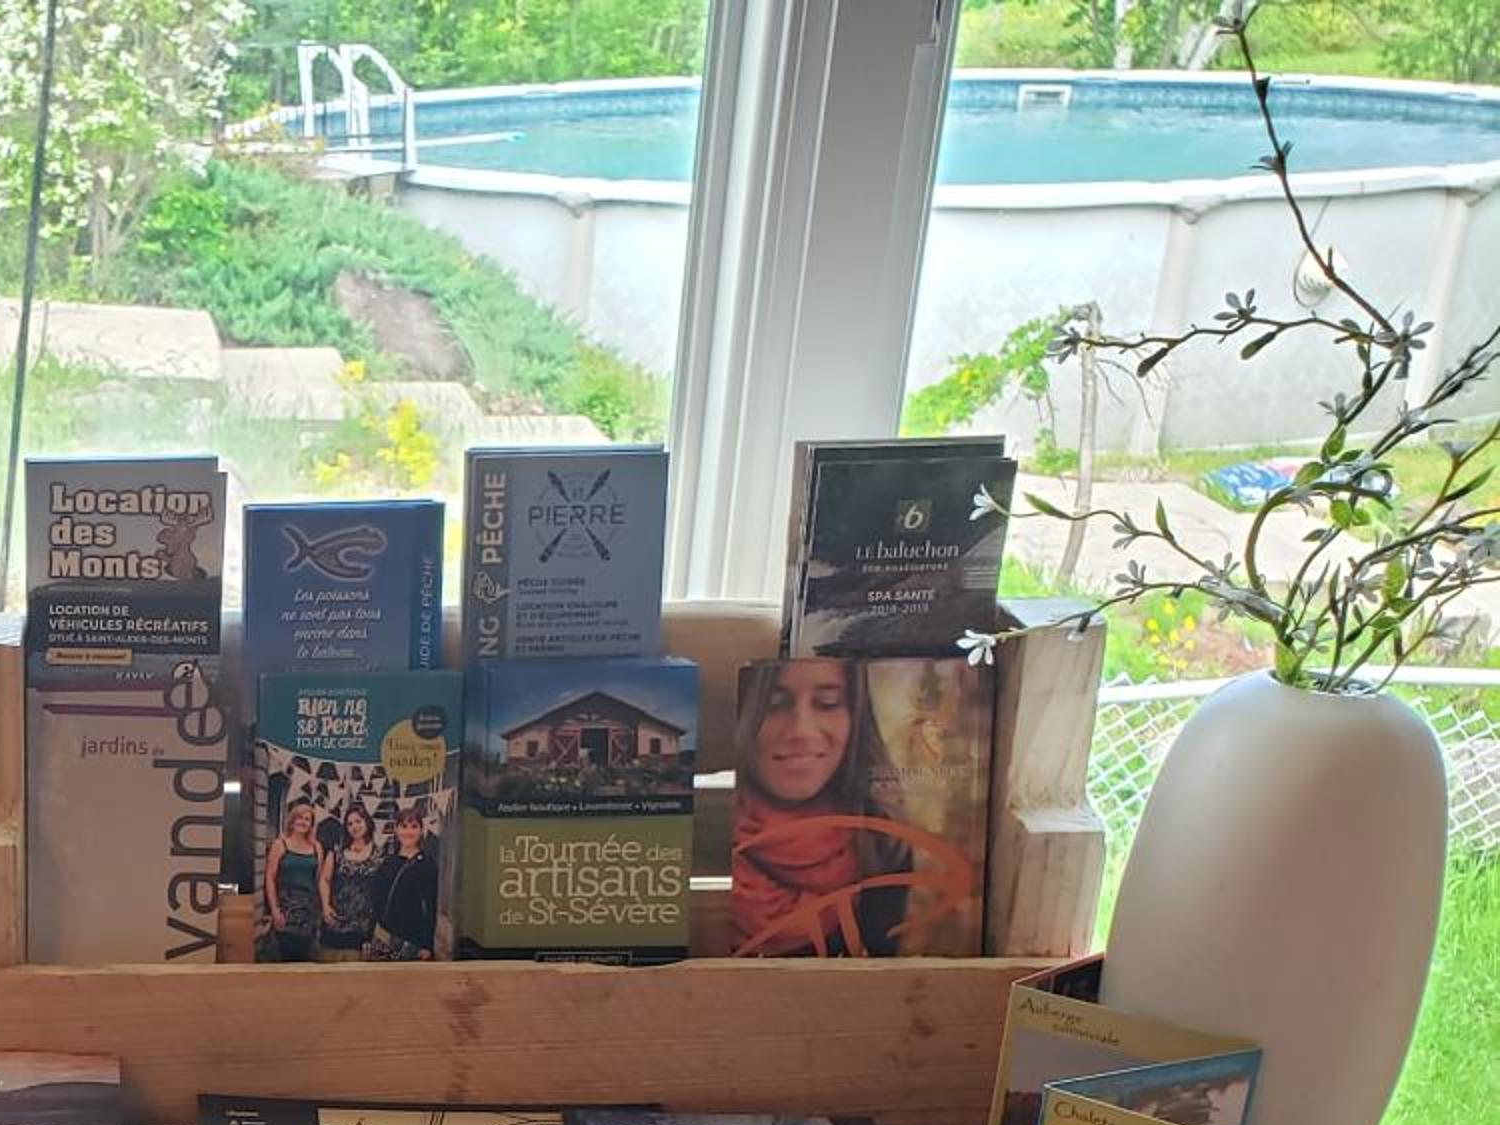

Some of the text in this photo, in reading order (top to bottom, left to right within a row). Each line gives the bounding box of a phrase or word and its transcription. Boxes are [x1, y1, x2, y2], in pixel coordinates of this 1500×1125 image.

[49, 481, 213, 516] Location
[476, 472, 507, 565] PÊCHE
[528, 503, 626, 526] PIERRE
[48, 515, 117, 548] des
[48, 548, 165, 580] Monts
[876, 539, 960, 560] baluchon
[49, 604, 130, 617] LOCATION DE
[867, 590, 892, 602] SPA
[49, 616, 209, 632] VÉHICULES RÉCRÉATIFS
[419, 635, 431, 670] UIDE
[296, 696, 339, 716] Rien
[296, 717, 318, 736] se
[80, 734, 149, 758] jardins
[500, 833, 684, 864] la Tournée des
[499, 861, 683, 899] artisans
[500, 894, 681, 926] de St-Sévère
[1019, 996, 1084, 1025] Auberge
